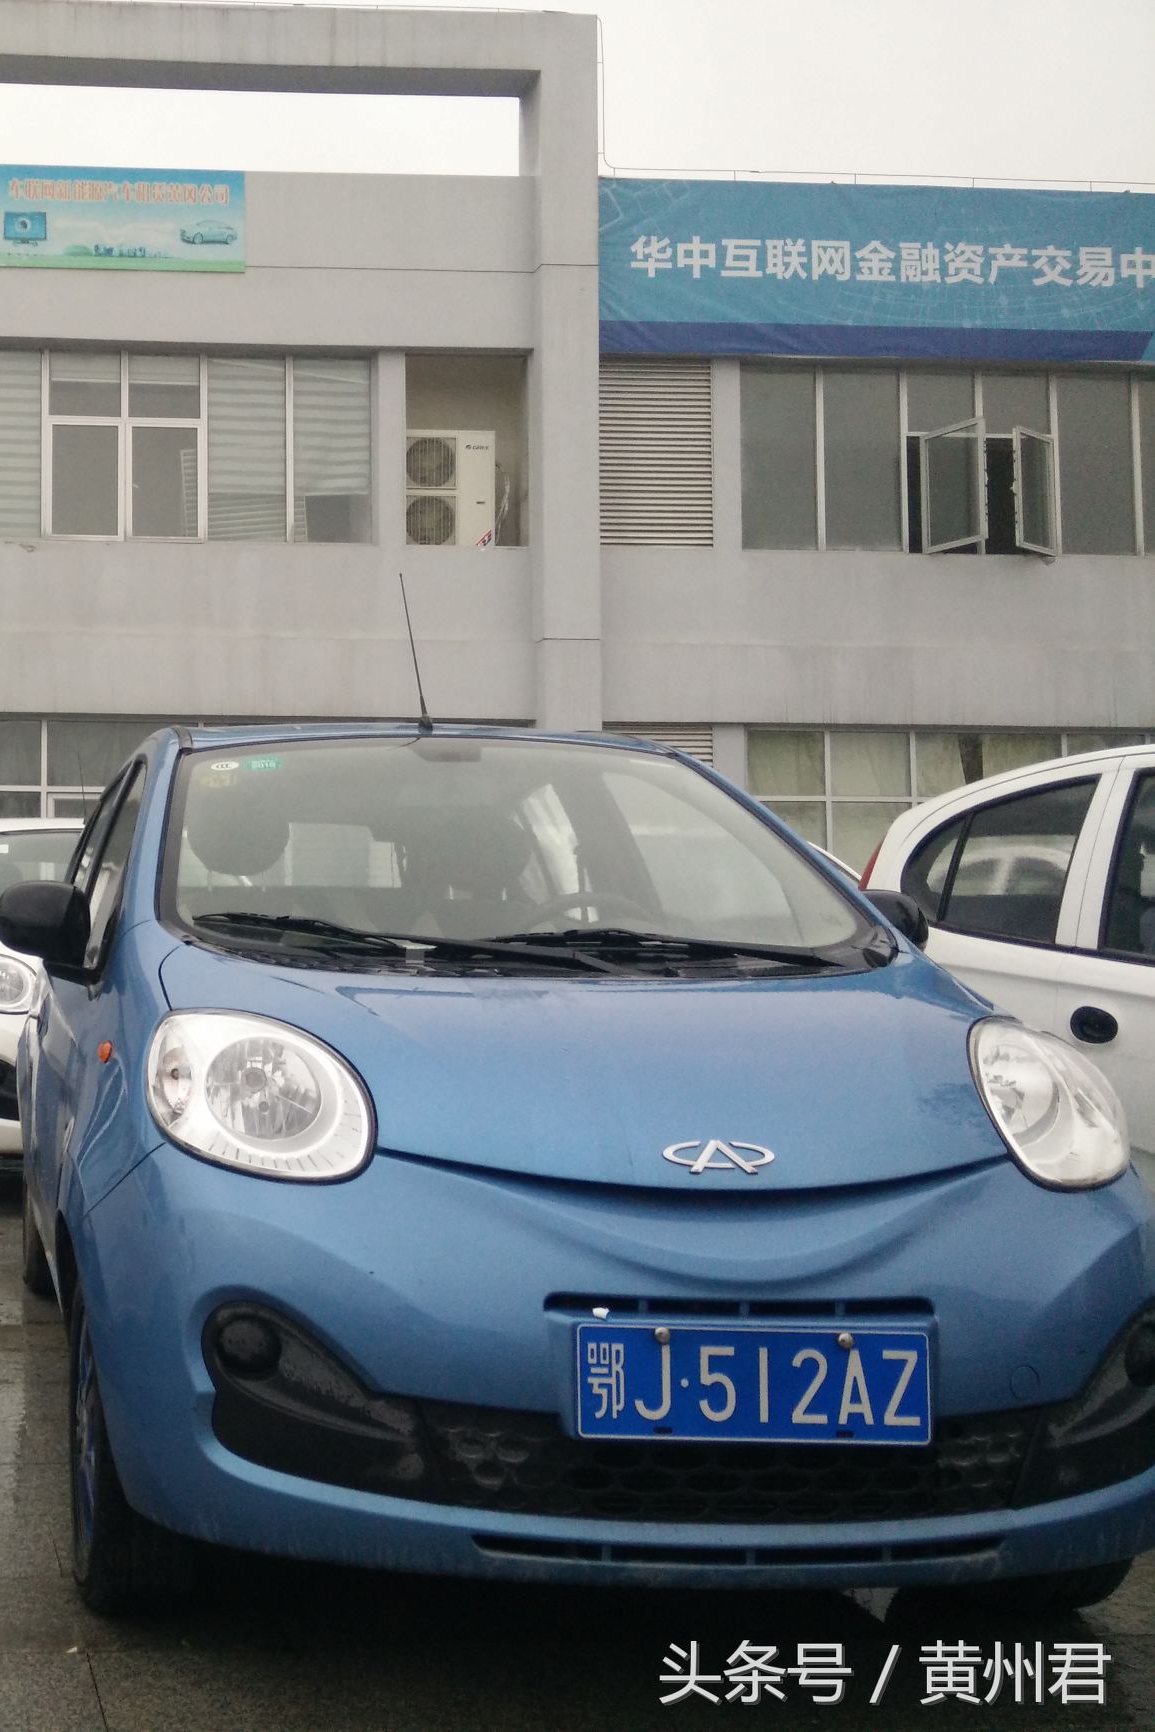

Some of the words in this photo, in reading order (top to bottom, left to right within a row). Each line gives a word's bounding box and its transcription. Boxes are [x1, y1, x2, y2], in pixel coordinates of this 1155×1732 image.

[630, 235, 1155, 289] 华中互联网金融资产交易中
